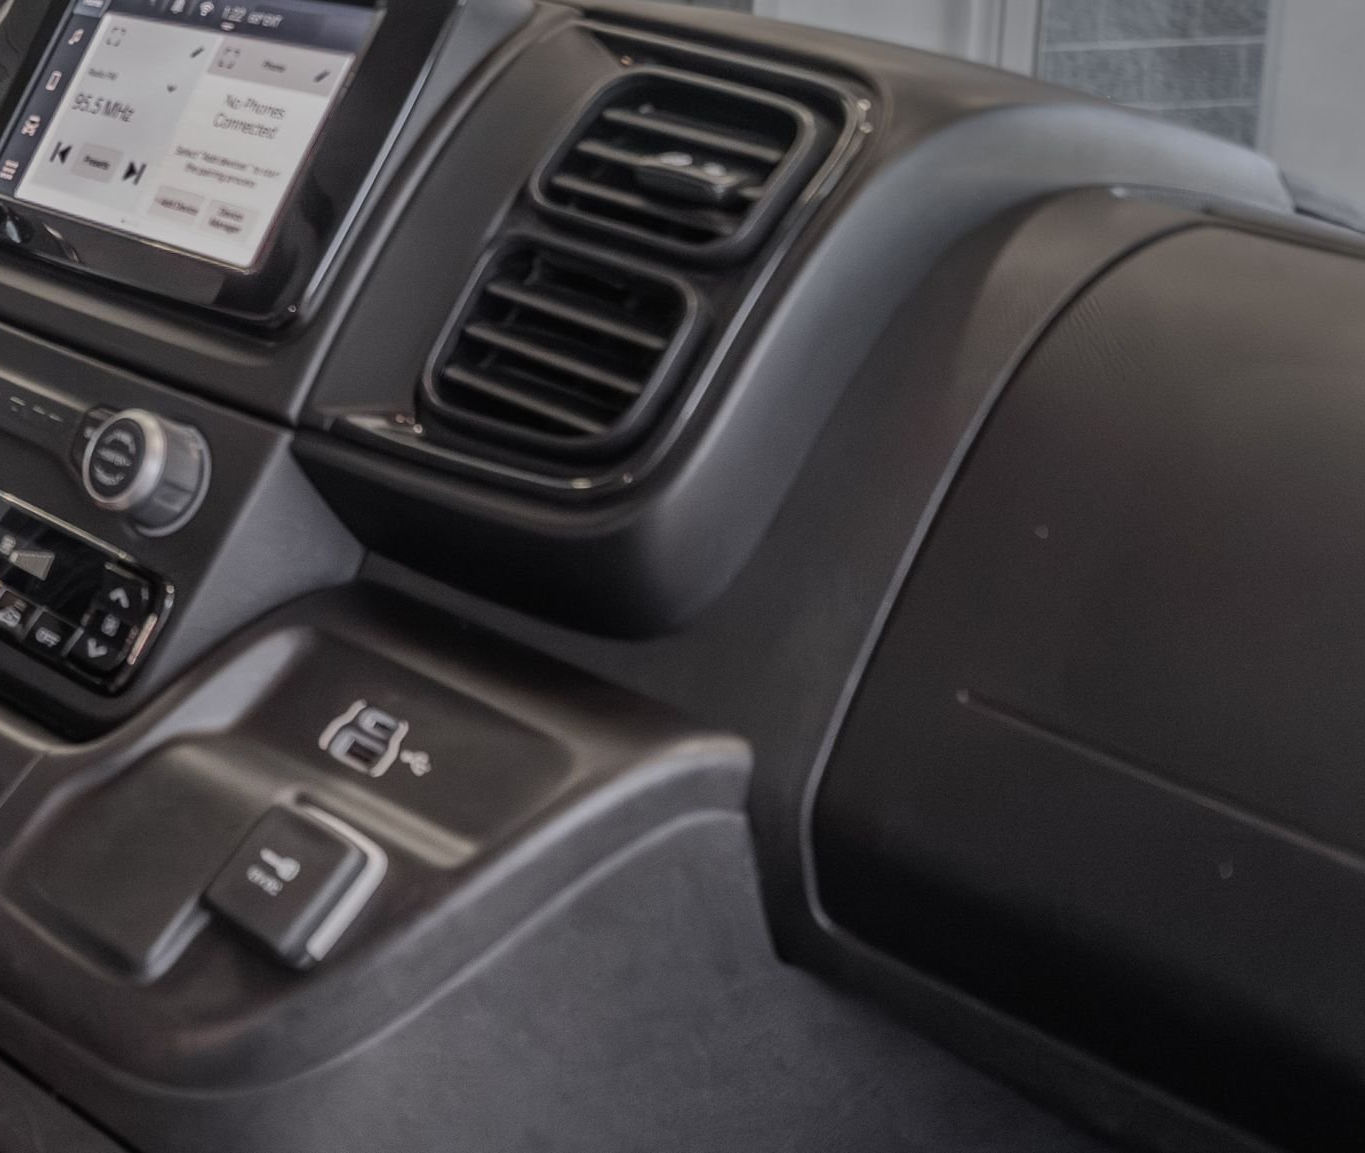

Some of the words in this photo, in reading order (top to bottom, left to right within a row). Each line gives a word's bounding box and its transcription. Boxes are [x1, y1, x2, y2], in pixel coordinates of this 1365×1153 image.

[72, 93, 104, 115] 95.5
[103, 100, 136, 123] MHz
[212, 113, 279, 140] Connected
